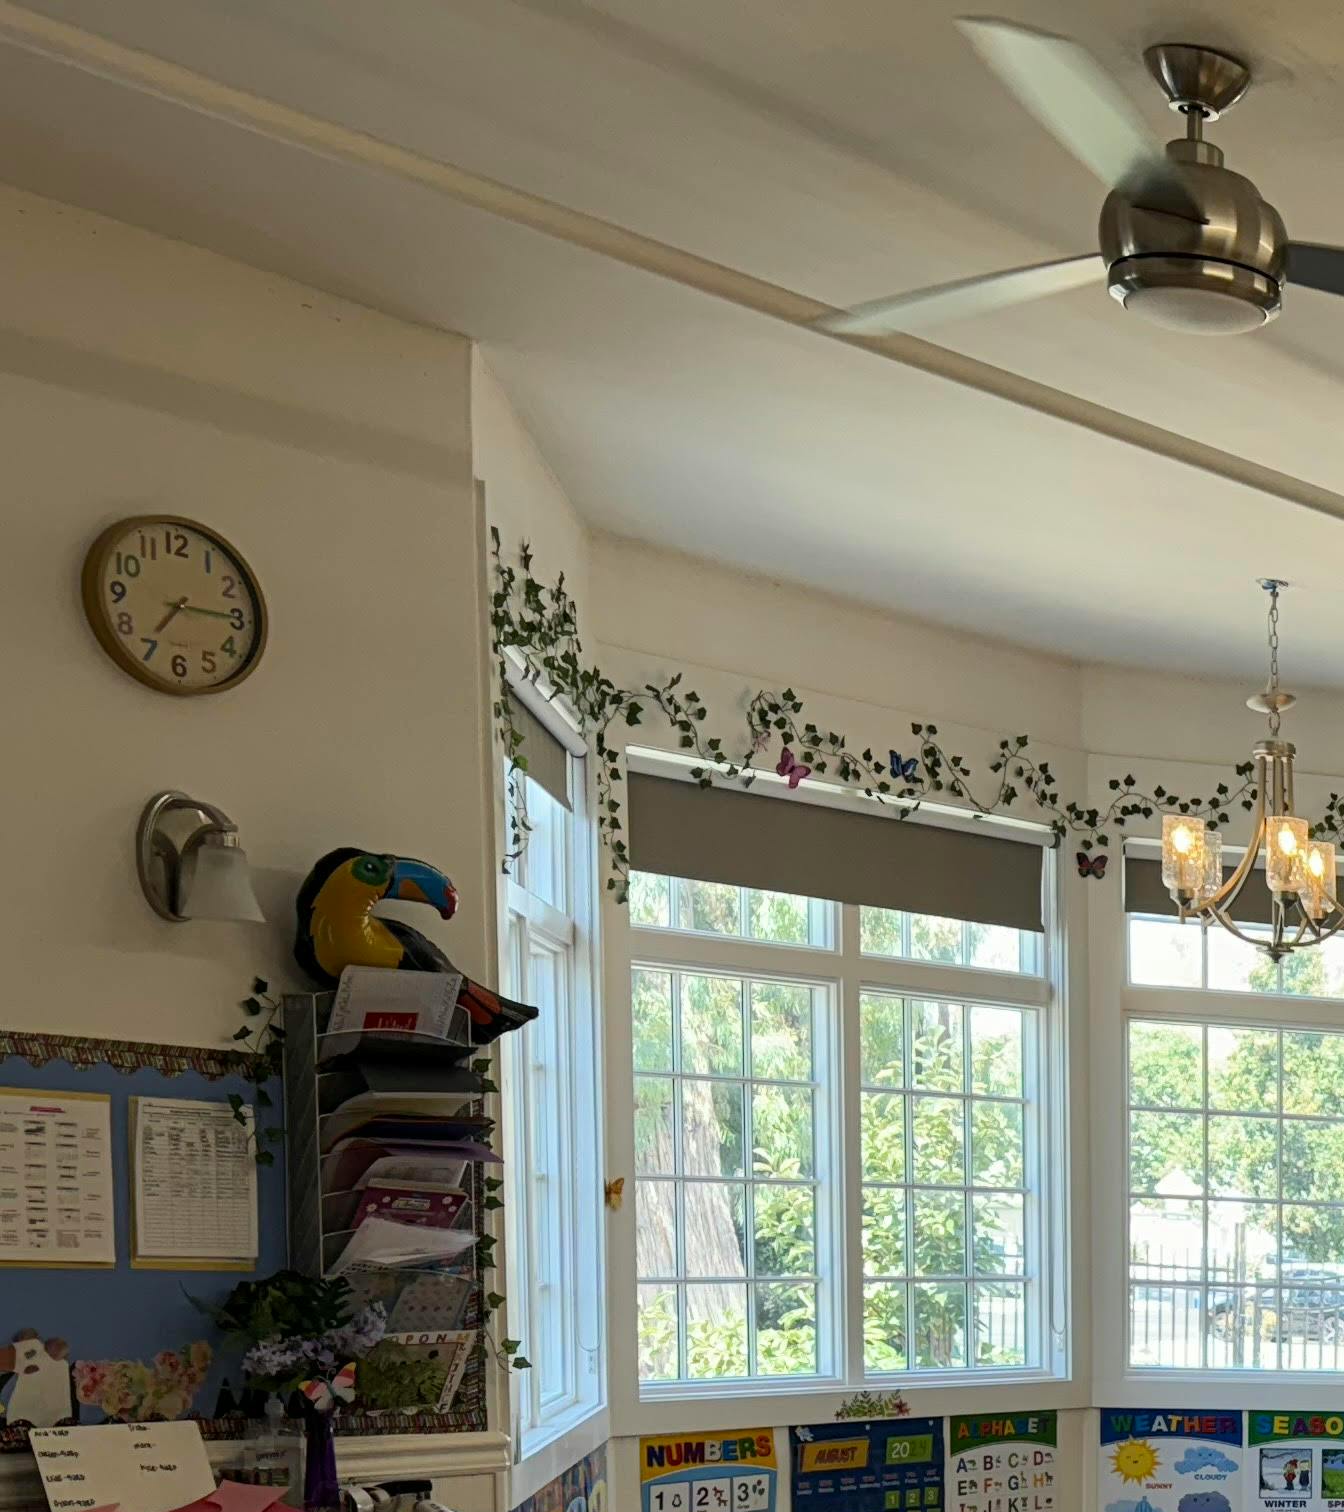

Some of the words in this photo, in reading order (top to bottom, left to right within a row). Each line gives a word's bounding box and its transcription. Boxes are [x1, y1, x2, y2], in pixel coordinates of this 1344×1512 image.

[140, 535, 157, 560] 11
[165, 531, 189, 558] 12
[116, 551, 141, 578] 10
[204, 550, 211, 574] 1
[110, 581, 127, 603] 9
[221, 576, 236, 599] 2
[118, 612, 134, 635] 8
[230, 608, 245, 631] 3
[140, 638, 158, 661] 7
[220, 636, 236, 658] 4
[171, 654, 188, 678] 6
[201, 651, 217, 674] 5
[957, 1416, 1049, 1440] ALPHABET
[1110, 1414, 1237, 1434] WEATHER
[646, 1435, 772, 1468] NUMBERS
[815, 1446, 858, 1465] AUGUST
[956, 1457, 968, 1474] A
[983, 1455, 994, 1471] B
[1008, 1453, 1019, 1468] C
[1033, 1451, 1044, 1466] D
[957, 1480, 968, 1496] E
[984, 1478, 993, 1494] F
[1008, 1475, 1019, 1491] G
[1033, 1473, 1044, 1488] H
[1194, 1473, 1228, 1482] CLOUDY
[655, 1491, 664, 1511] 1
[696, 1486, 709, 1507] 2
[737, 1482, 750, 1502] 3
[1008, 1497, 1019, 1512] K
[1034, 1495, 1043, 1510] L
[1264, 1500, 1307, 1509] WINTER
